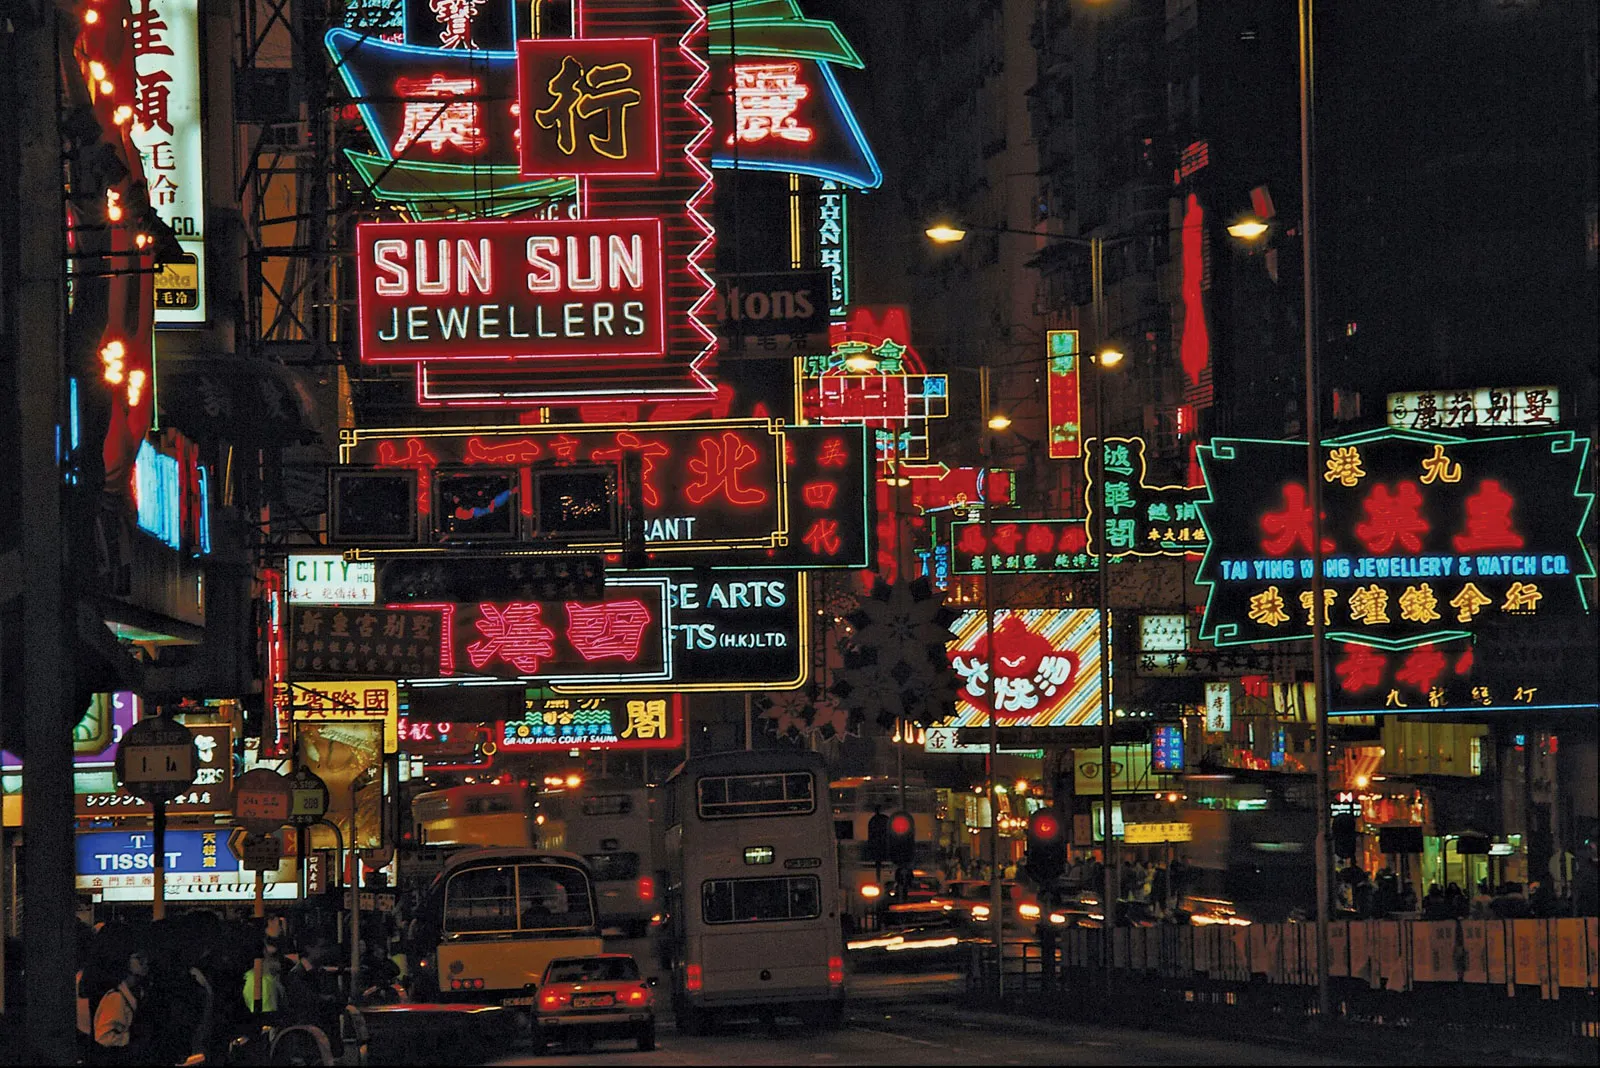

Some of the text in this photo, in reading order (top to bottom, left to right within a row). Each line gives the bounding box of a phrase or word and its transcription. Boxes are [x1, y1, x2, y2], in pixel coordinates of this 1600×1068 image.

[535, 55, 641, 159] 行
[374, 235, 645, 296] SUN SUN
[378, 301, 646, 342] JEWELLERS
[296, 561, 351, 582] CITY
[1221, 555, 1569, 580] TAI YING WNG JEWELLERY & WATCH CO.
[706, 581, 786, 608] ARTS
[620, 699, 667, 739] 閣
[503, 735, 618, 746] GRAND KING COURT SAUNA
